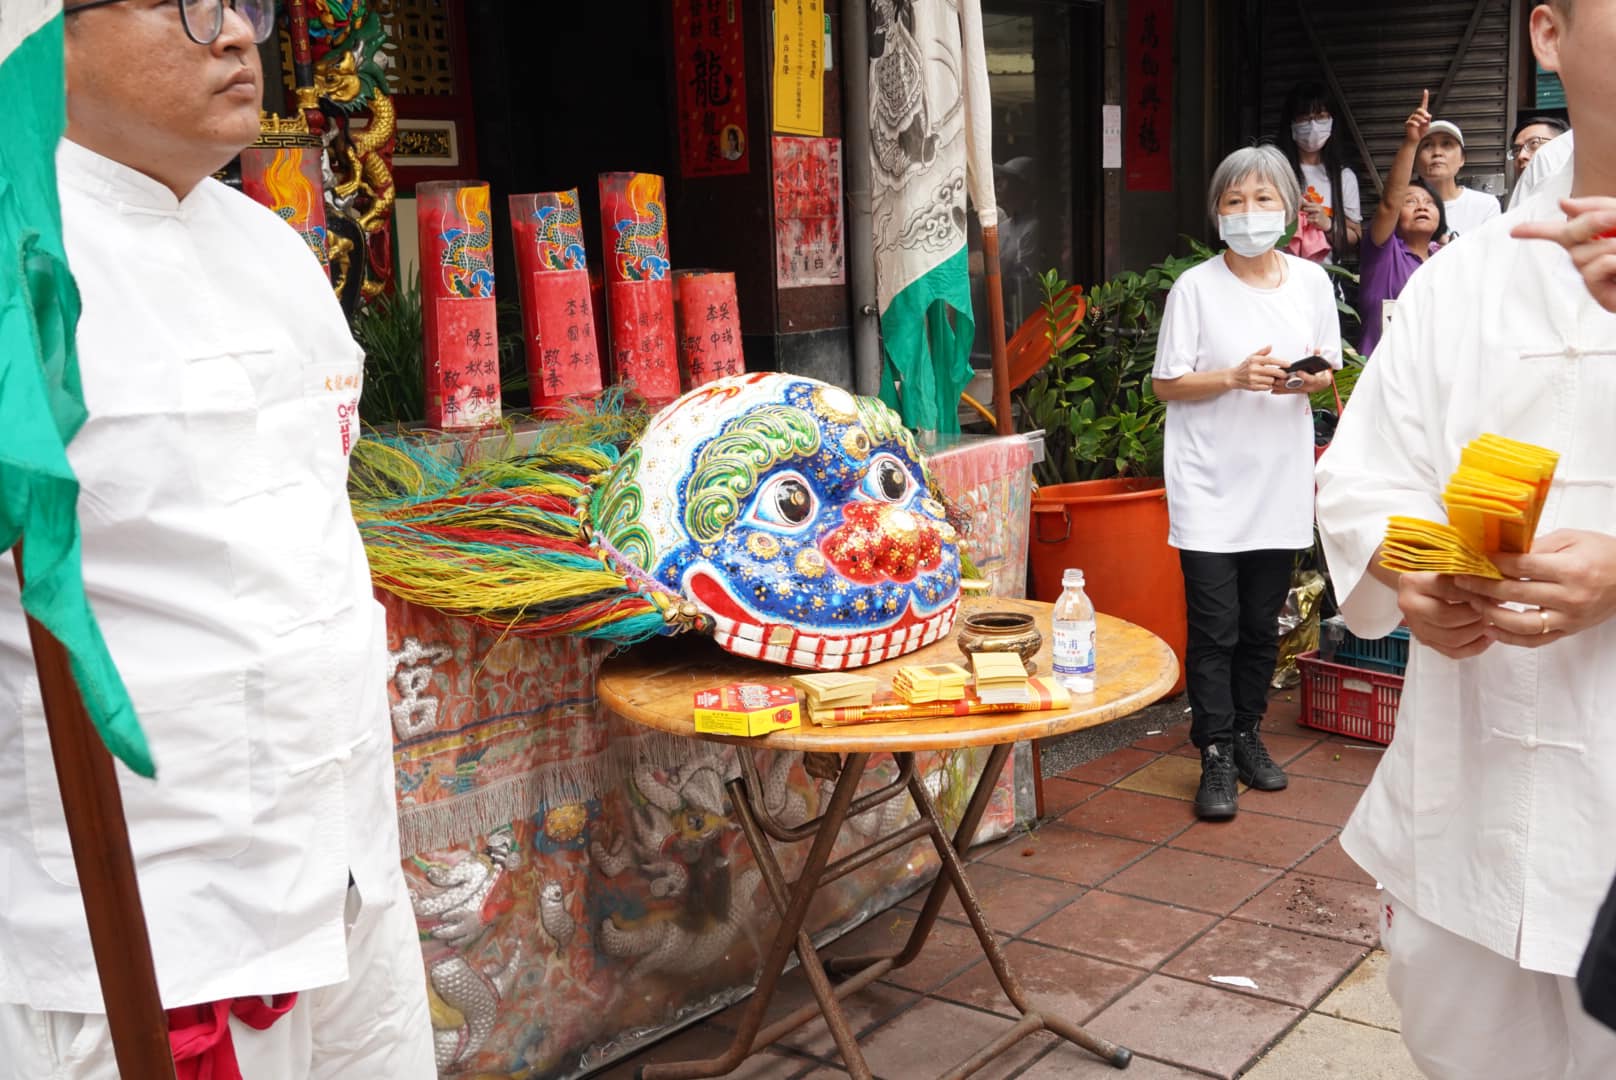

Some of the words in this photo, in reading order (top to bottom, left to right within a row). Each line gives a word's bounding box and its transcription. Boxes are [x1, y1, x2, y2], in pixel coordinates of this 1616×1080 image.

[443, 369, 462, 425] 敬奉
[545, 348, 564, 394] 敬奉
[386, 636, 453, 742] 宮
